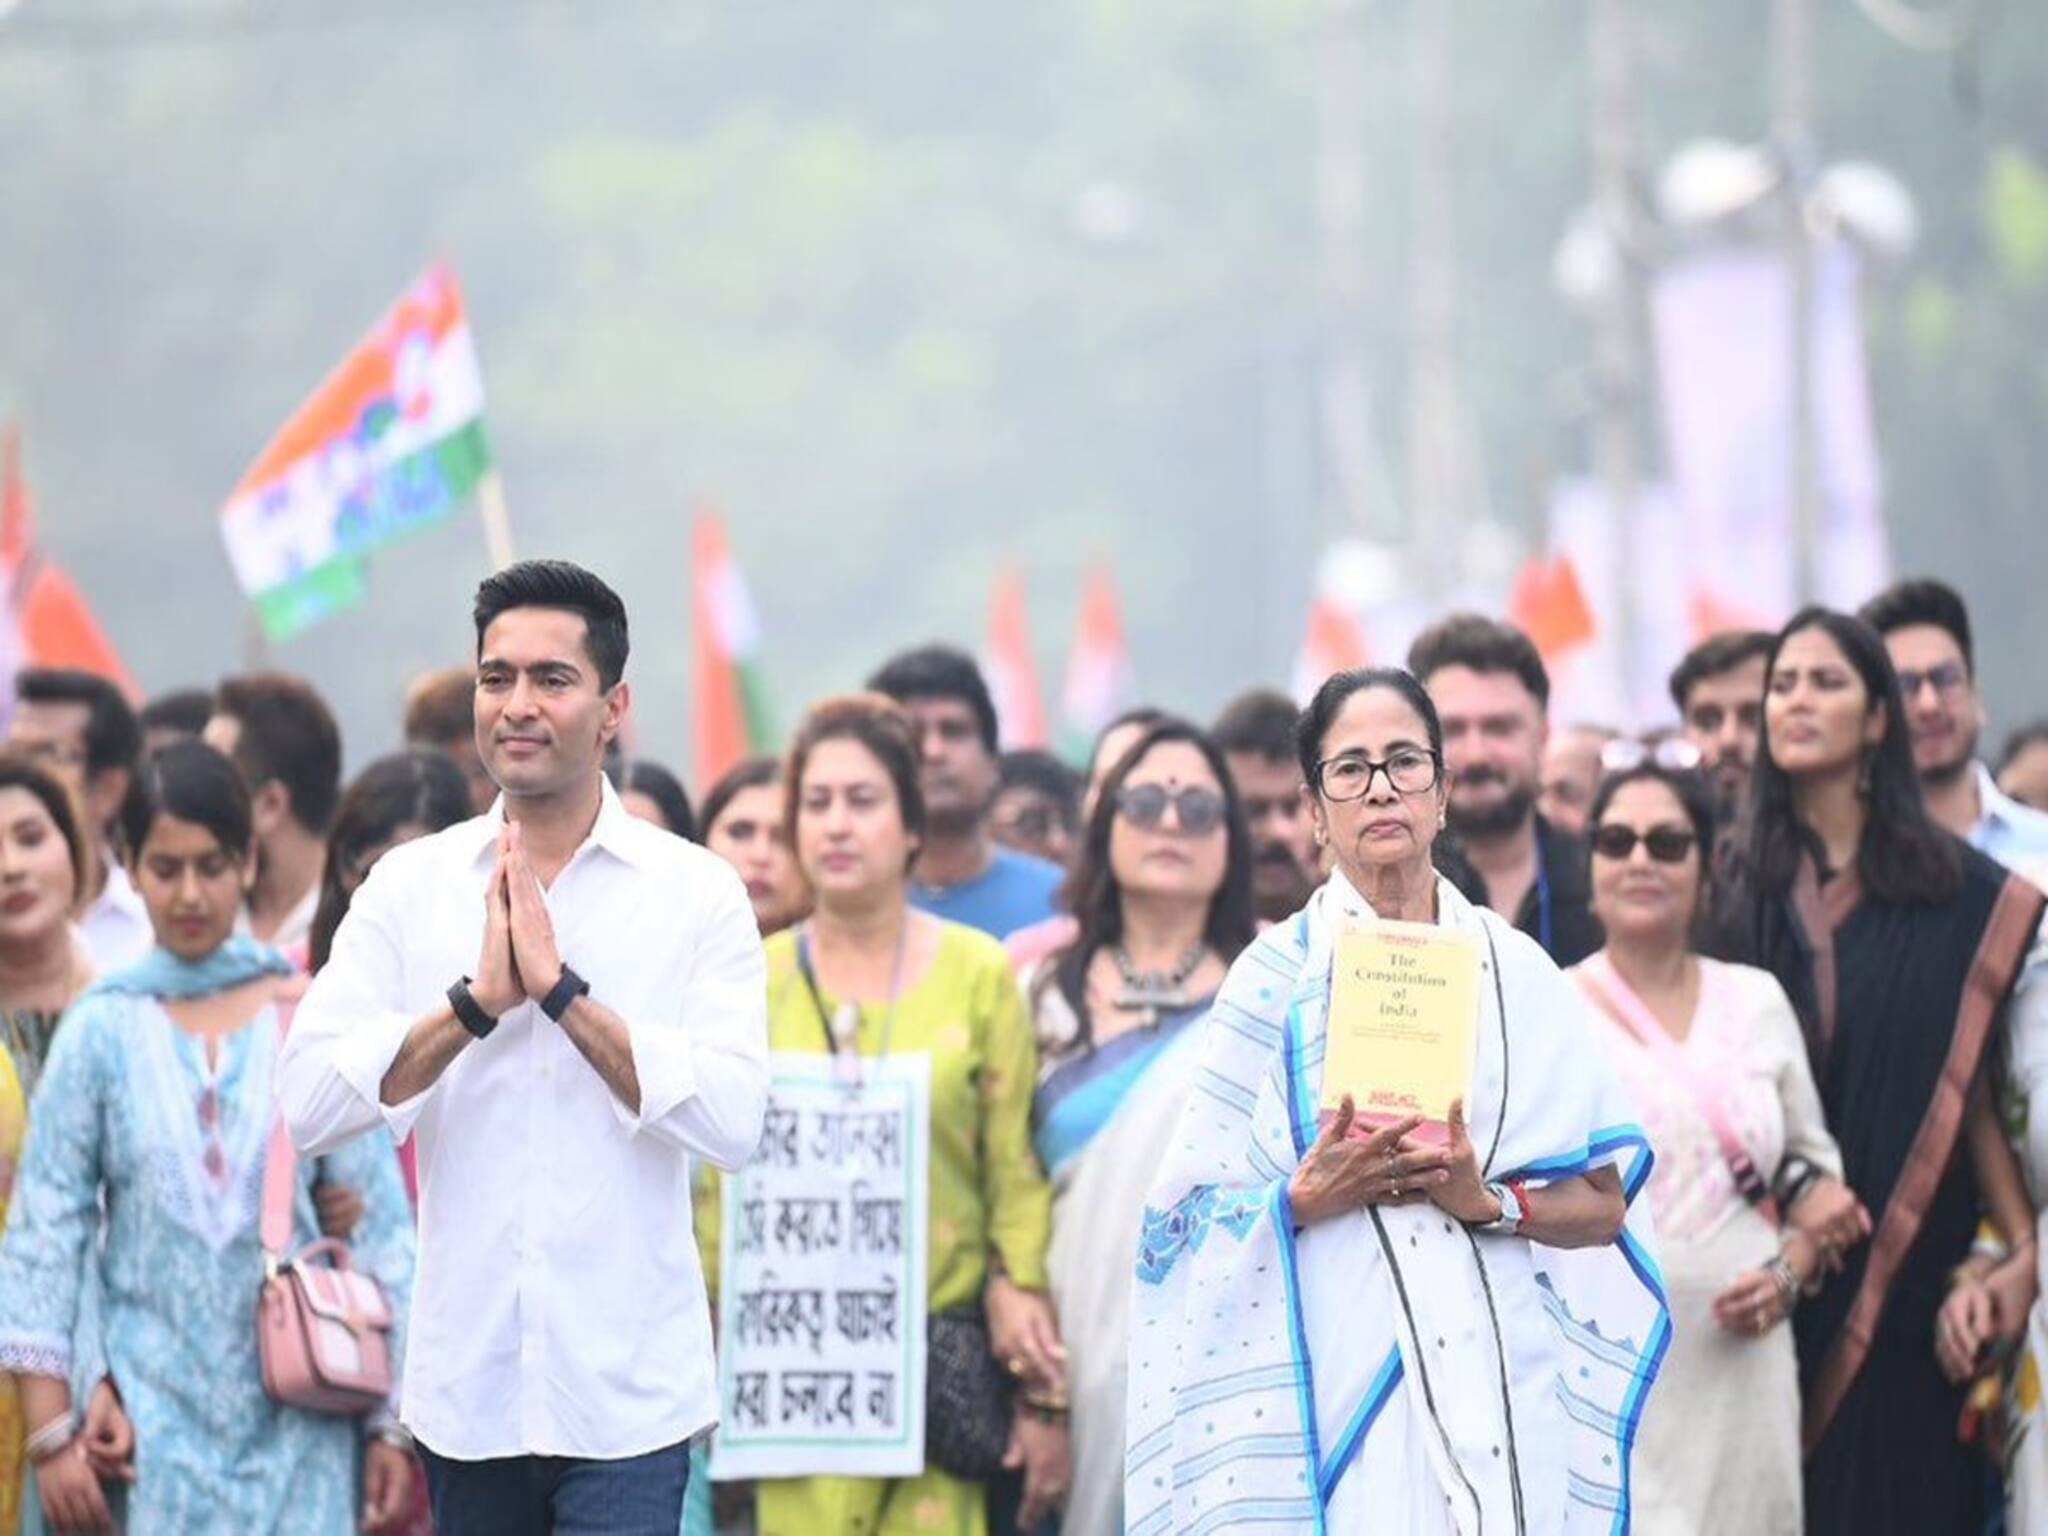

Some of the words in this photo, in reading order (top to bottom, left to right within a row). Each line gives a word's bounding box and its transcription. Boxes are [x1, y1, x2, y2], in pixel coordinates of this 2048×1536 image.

[1390, 953, 1417, 968] The
[1354, 967, 1446, 987] Constitution
[1392, 988, 1407, 1000] of
[1379, 1002, 1418, 1018] India
[781, 1370, 855, 1428] চলবে
[866, 1371, 895, 1428] না
